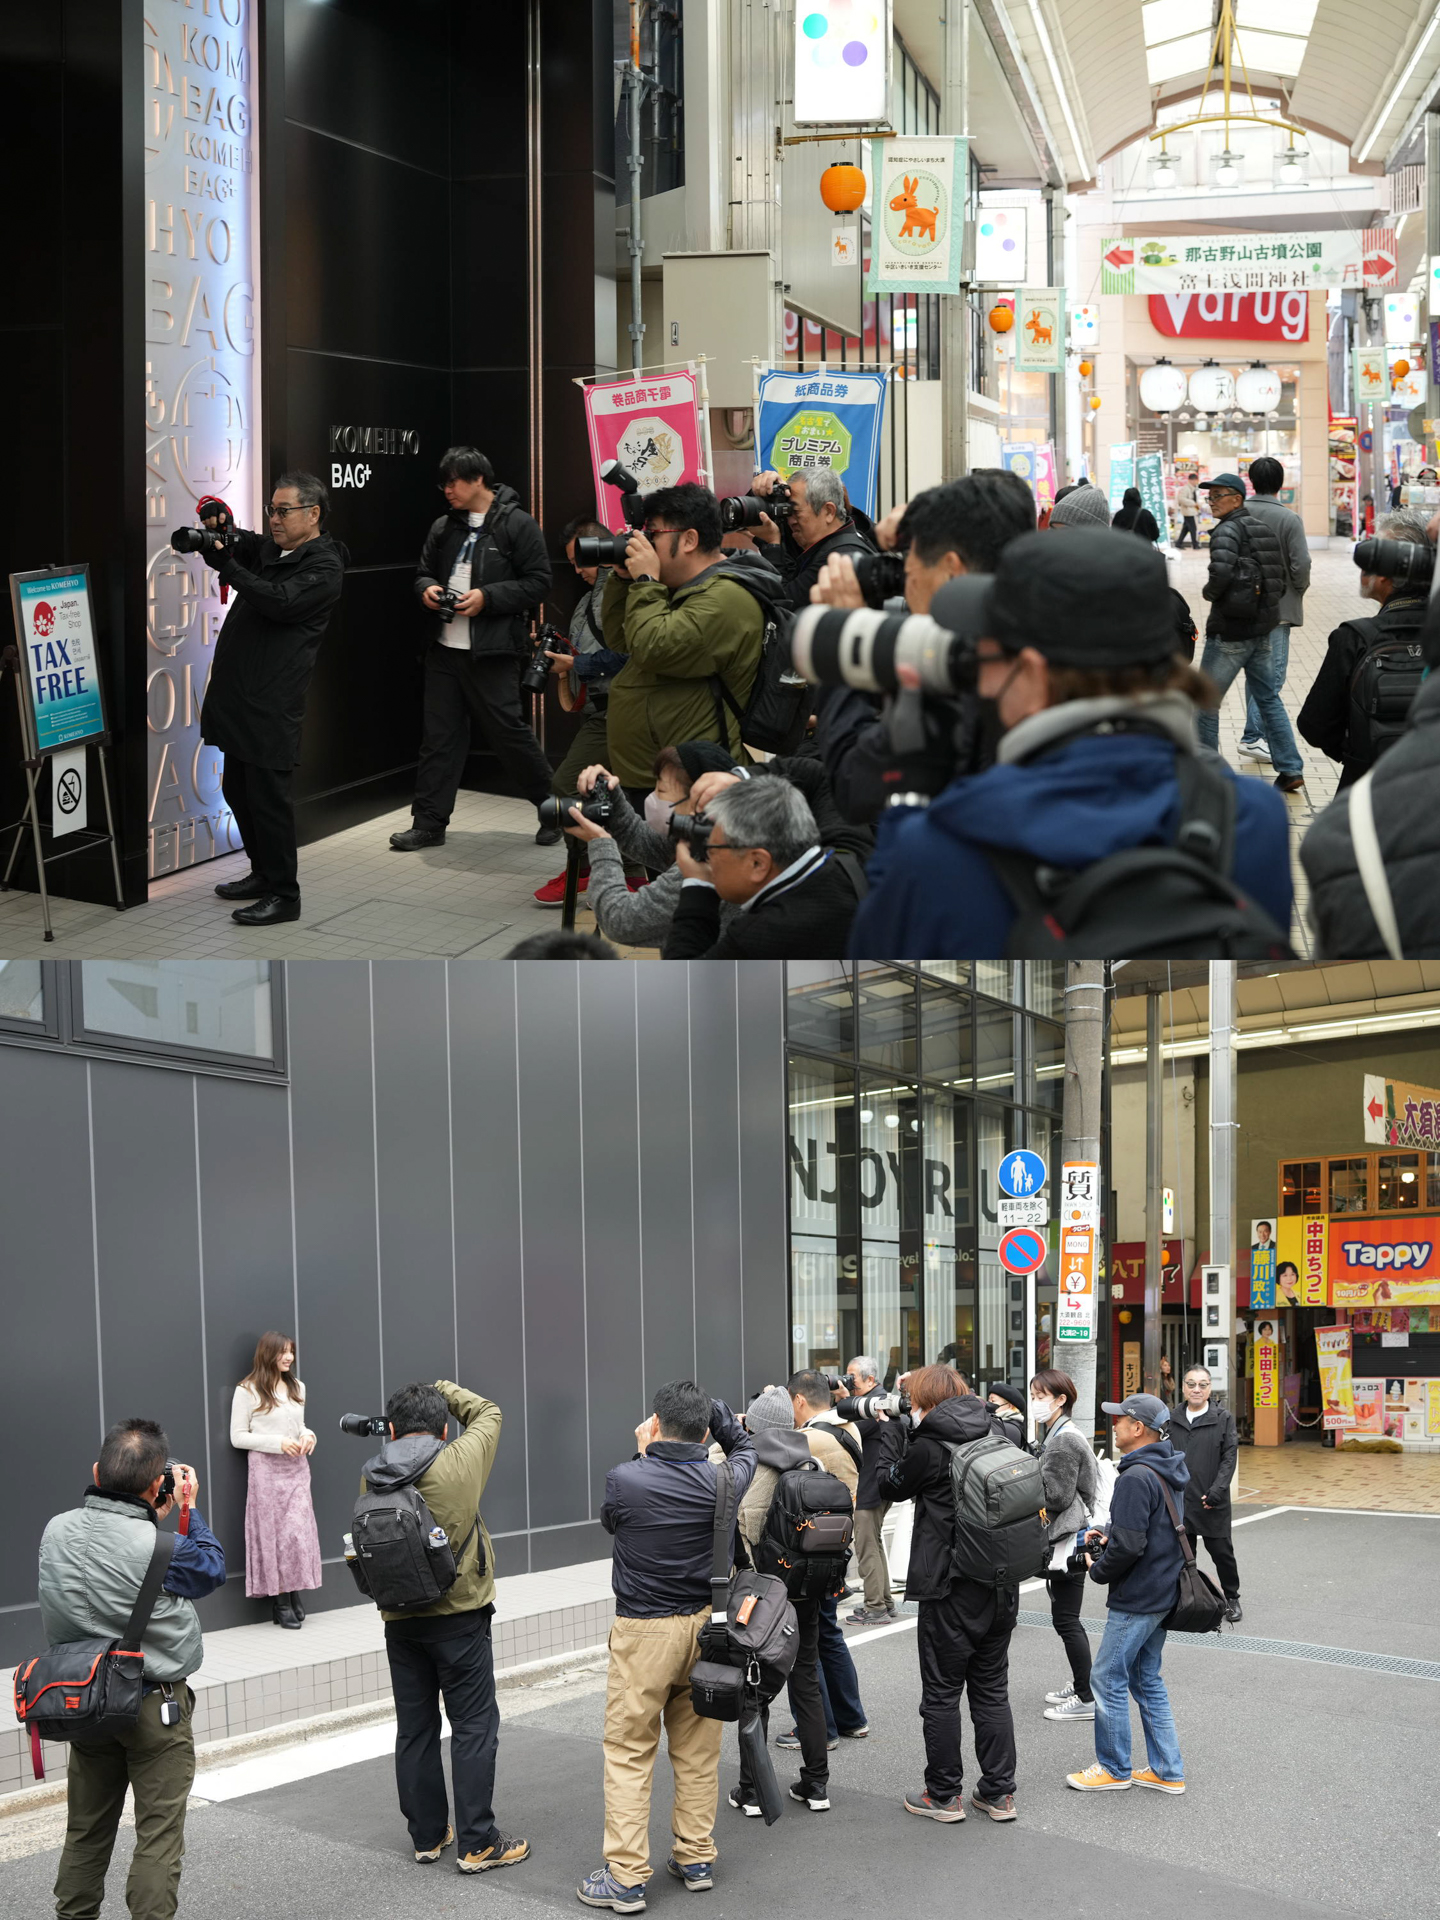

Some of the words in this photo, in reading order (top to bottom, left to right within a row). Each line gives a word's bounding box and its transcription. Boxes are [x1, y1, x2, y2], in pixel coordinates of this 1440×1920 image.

[1185, 242, 1322, 262] 那古野山古墳公園
[1179, 270, 1311, 290] 富士浅間神社
[794, 382, 849, 398] 紙商品券
[329, 425, 420, 455] KOMEHYO
[781, 437, 842, 454] プレミアム
[788, 454, 831, 468] 商品券
[331, 463, 372, 489] BAG+
[50, 579, 79, 590] KOMEHYO
[59, 610, 81, 620] Tax-free
[68, 620, 81, 629] Shop
[30, 638, 72, 672] TAX
[35, 666, 89, 705] FREE
[1065, 1171, 1094, 1200] 質
[1001, 1201, 1043, 1211] 軽車両を除く
[1306, 1221, 1324, 1304] 中田ちづこ
[1343, 1243, 1431, 1269] Tappy
[1252, 1250, 1270, 1304] 藤川政人
[1259, 1345, 1272, 1406] 中田ちづこ
